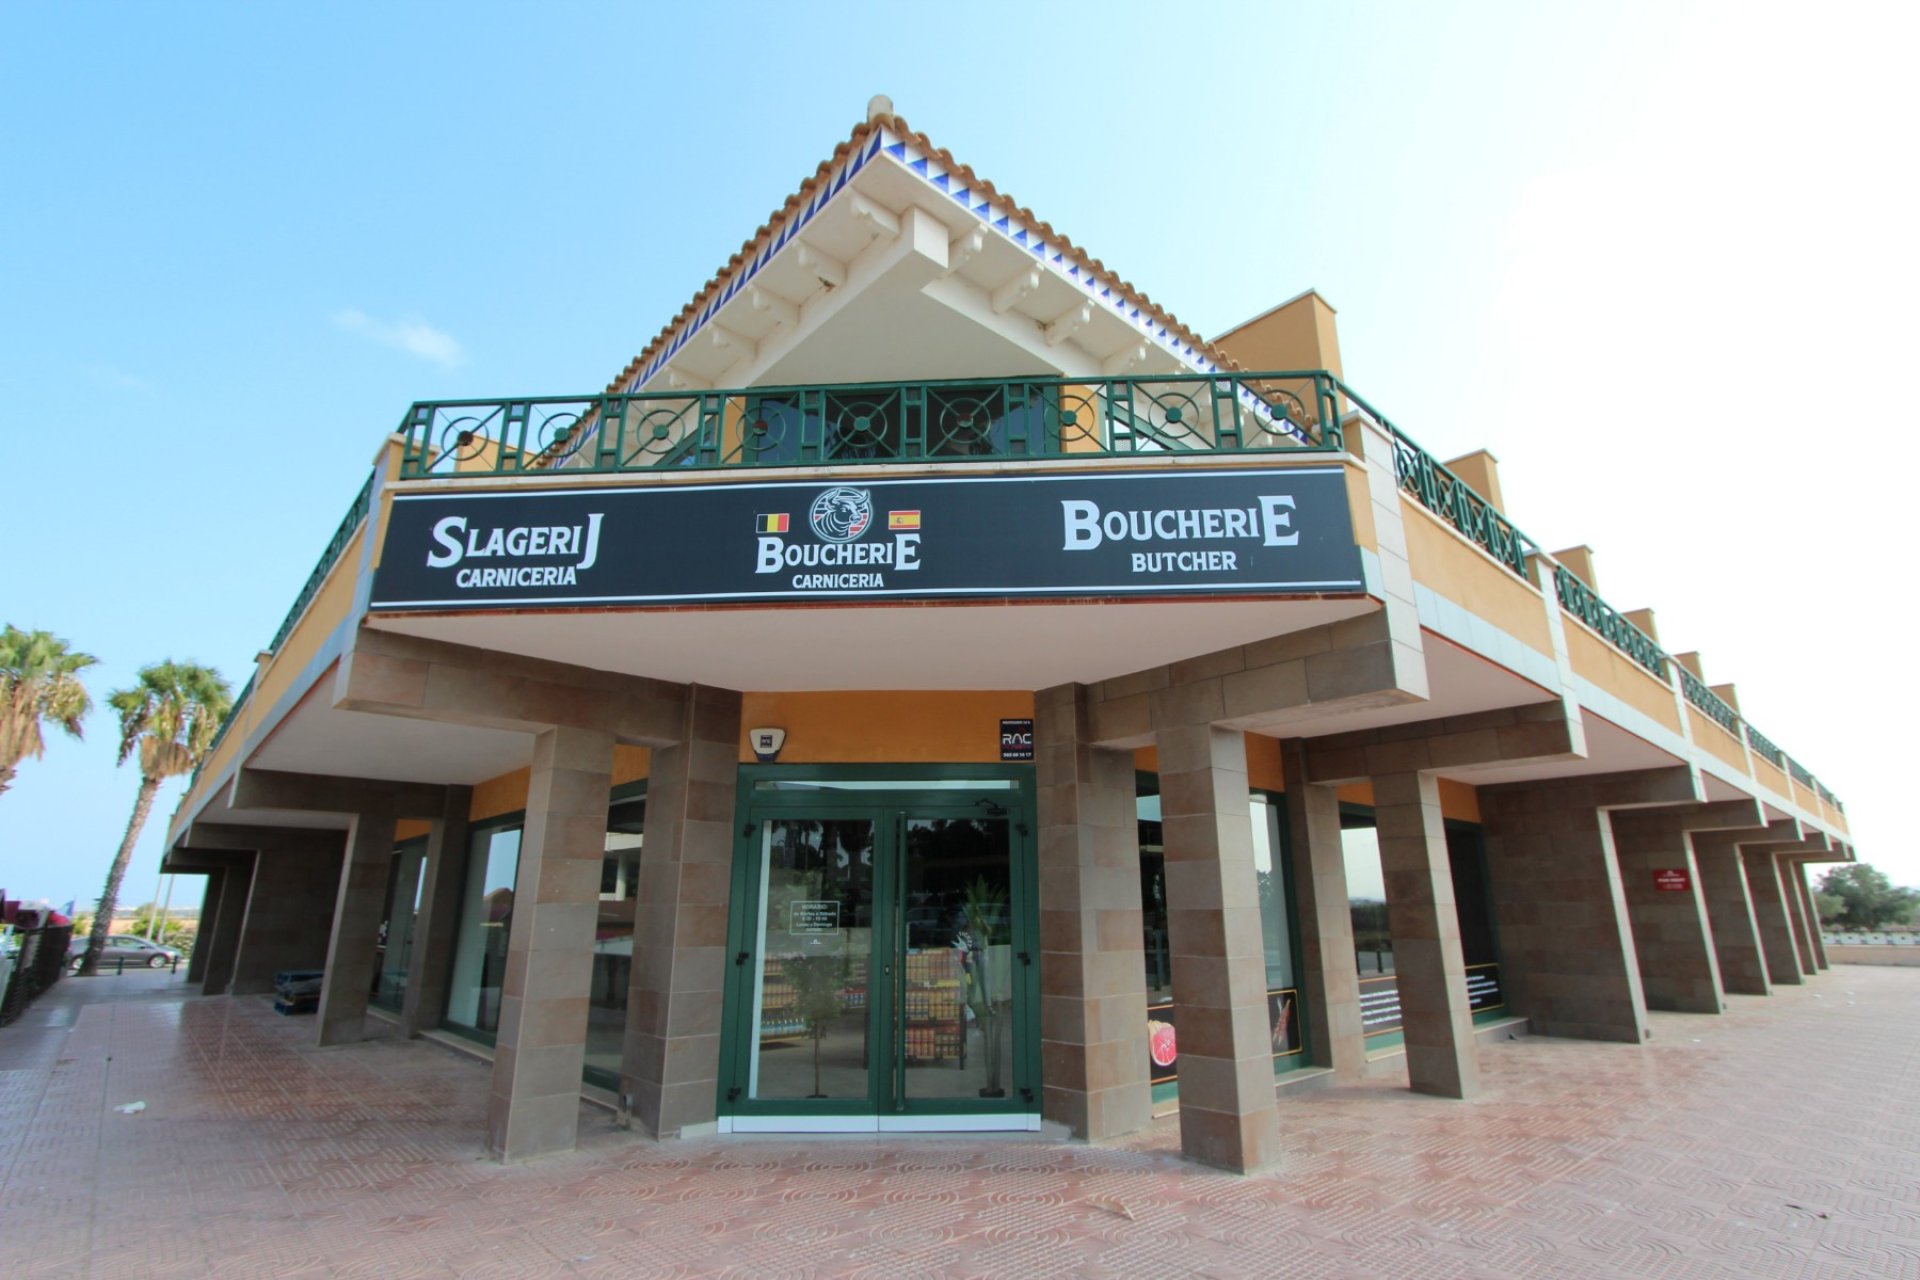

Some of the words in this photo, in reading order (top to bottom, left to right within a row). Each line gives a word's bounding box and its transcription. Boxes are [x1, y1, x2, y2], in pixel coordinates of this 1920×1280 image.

[1061, 495, 1299, 551] BOUCHERIE
[426, 513, 605, 569] SLAGERIJ
[755, 532, 921, 574] BOUCHERIE
[1131, 551, 1238, 573] BUTCHER
[456, 566, 577, 588] CARNICERIA
[792, 573, 887, 590] CARNICERIA
[1002, 733, 1032, 745] RAC
